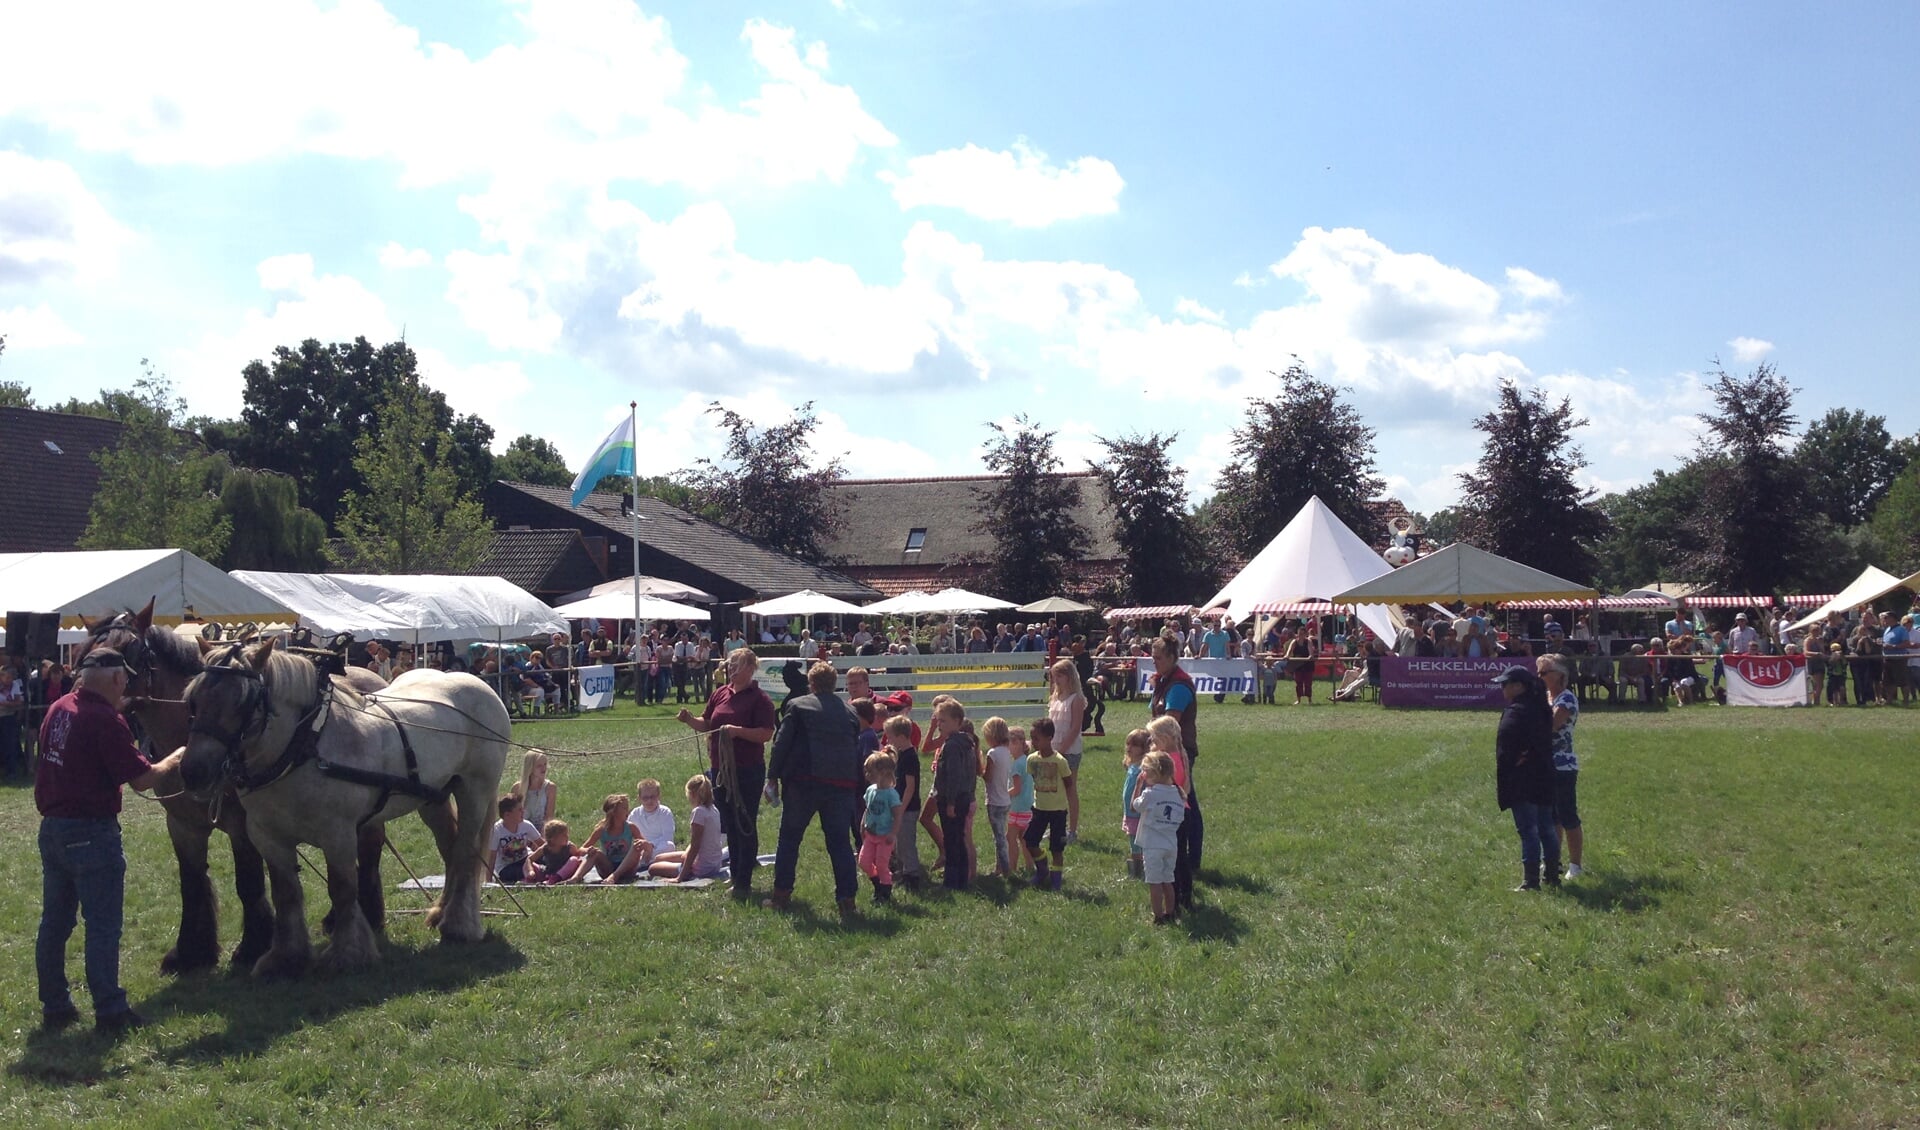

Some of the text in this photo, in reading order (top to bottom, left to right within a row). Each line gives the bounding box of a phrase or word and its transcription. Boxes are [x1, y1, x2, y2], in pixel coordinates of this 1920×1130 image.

[1408, 661, 1511, 671] HEKKELMAN
[1748, 661, 1781, 680] LELY
[1140, 674, 1255, 691] Hmann
[1398, 681, 1430, 690] specialist
[1440, 682, 1473, 690] agrarisch
